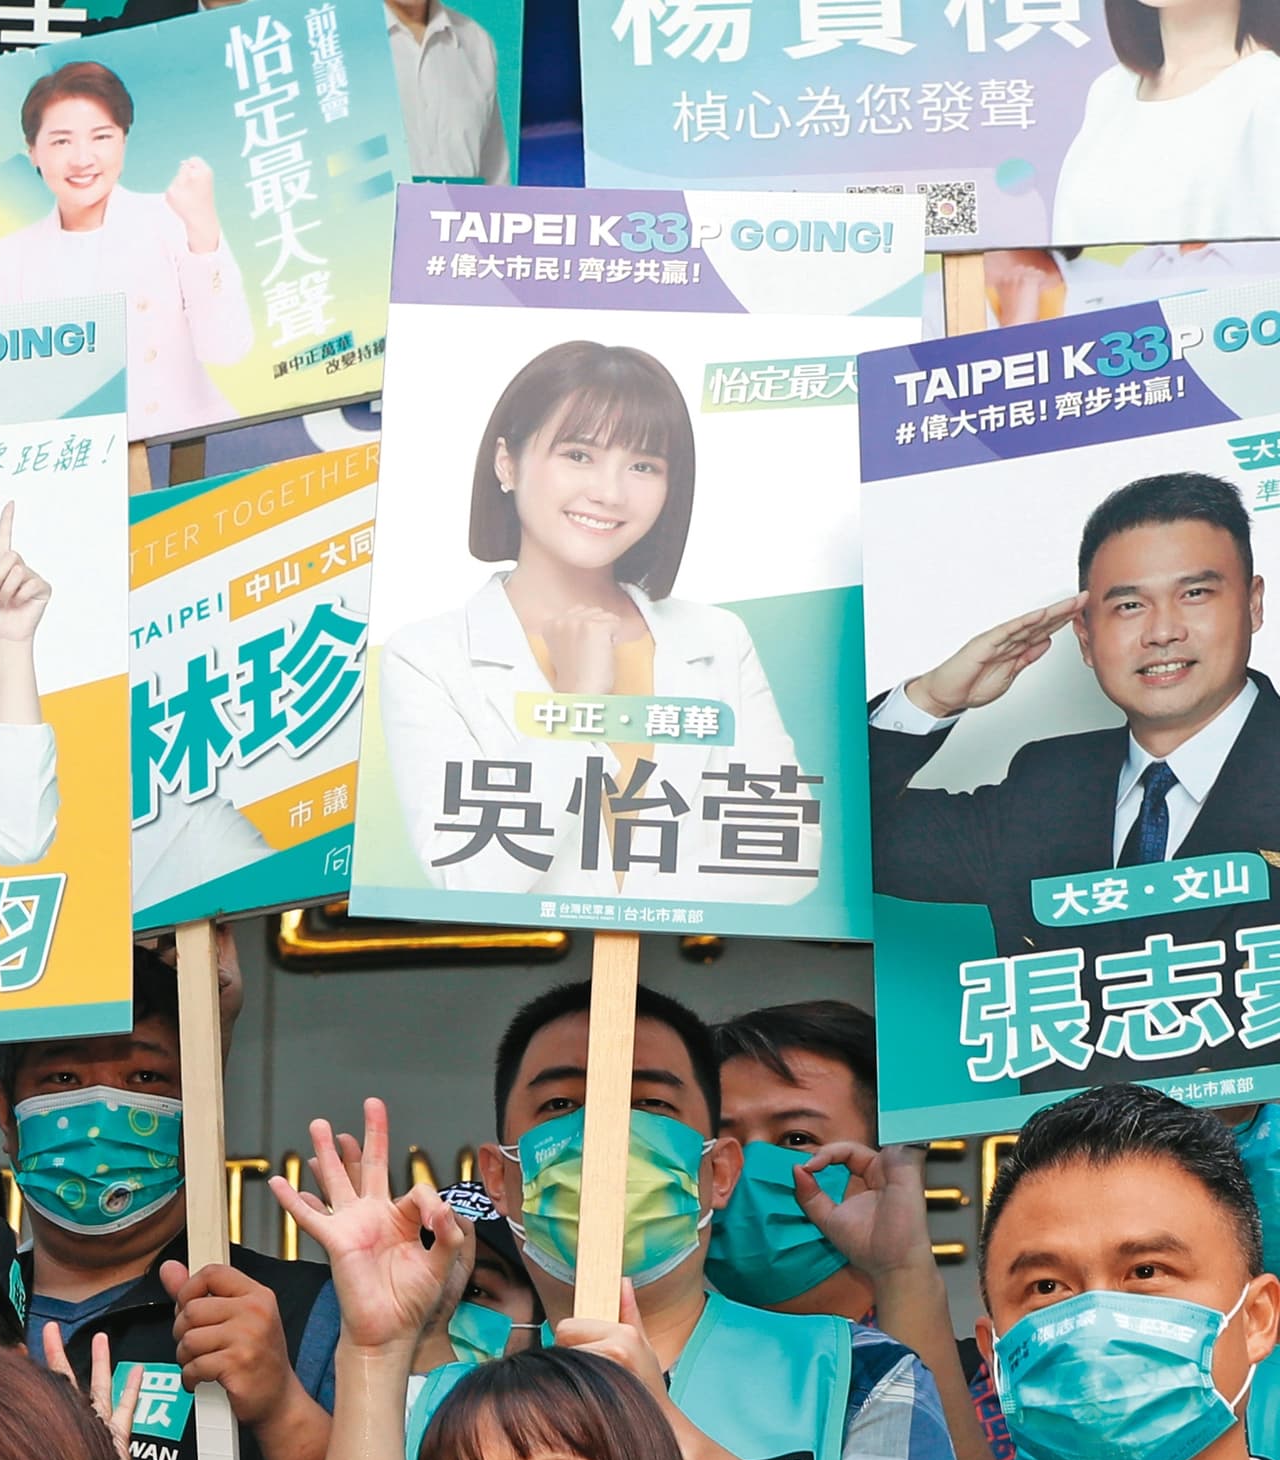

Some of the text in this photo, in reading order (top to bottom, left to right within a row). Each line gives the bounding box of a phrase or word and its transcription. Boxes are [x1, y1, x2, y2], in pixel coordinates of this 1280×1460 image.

[304, 3, 349, 123] 前進議會
[672, 77, 1037, 144] 楨心為您發聲
[225, 15, 337, 349] 怡定最大聲
[428, 210, 576, 247] TAIPEI
[730, 219, 894, 254] GOING!
[894, 350, 1050, 407] TAIPEI
[130, 593, 223, 650] TAIPEI
[531, 700, 721, 740] 中正・萬華
[428, 755, 826, 879] 吳怡萱
[1050, 860, 1251, 920] 大安・文山
